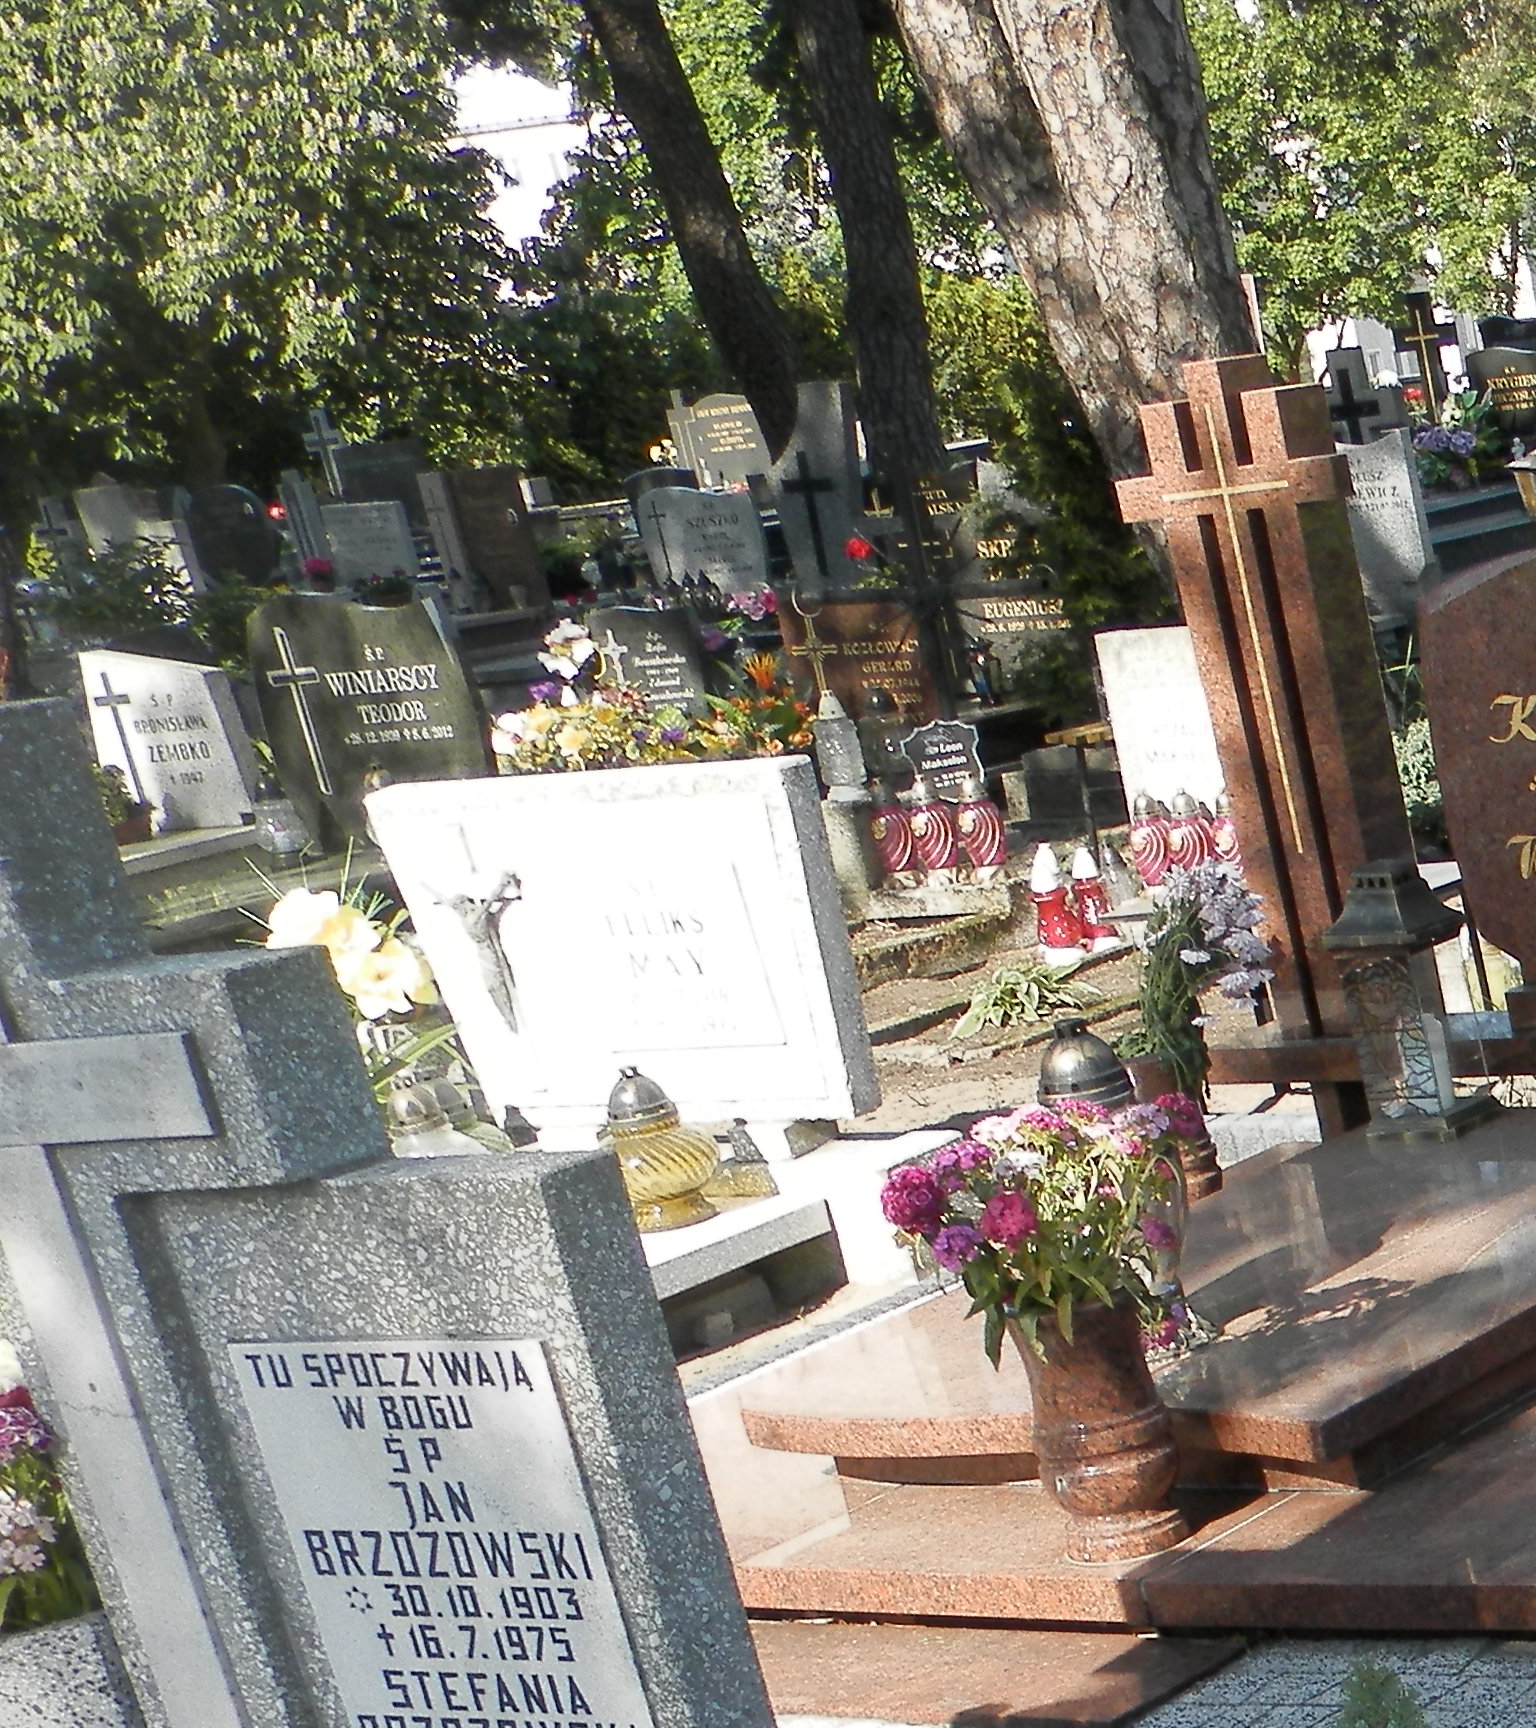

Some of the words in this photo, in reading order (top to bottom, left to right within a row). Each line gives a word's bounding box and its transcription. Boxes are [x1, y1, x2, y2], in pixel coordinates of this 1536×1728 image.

[324, 663, 440, 697] WINIARSCY
[134, 715, 209, 735] BRONISŁAWA
[356, 700, 429, 725] TEODOR
[148, 740, 211, 763] ZEMBKO
[245, 1354, 294, 1389] TU
[303, 1349, 535, 1393] SPOCZYWAJĄ
[332, 1395, 366, 1430] W
[378, 1395, 473, 1430] BOGU
[388, 1481, 476, 1530] JAN
[304, 1529, 595, 1581] BRZOZOWSKI
[384, 1583, 584, 1621] 30.10.1903
[409, 1625, 576, 1663] 16.7.1975
[382, 1669, 593, 1716] STEFANIA
